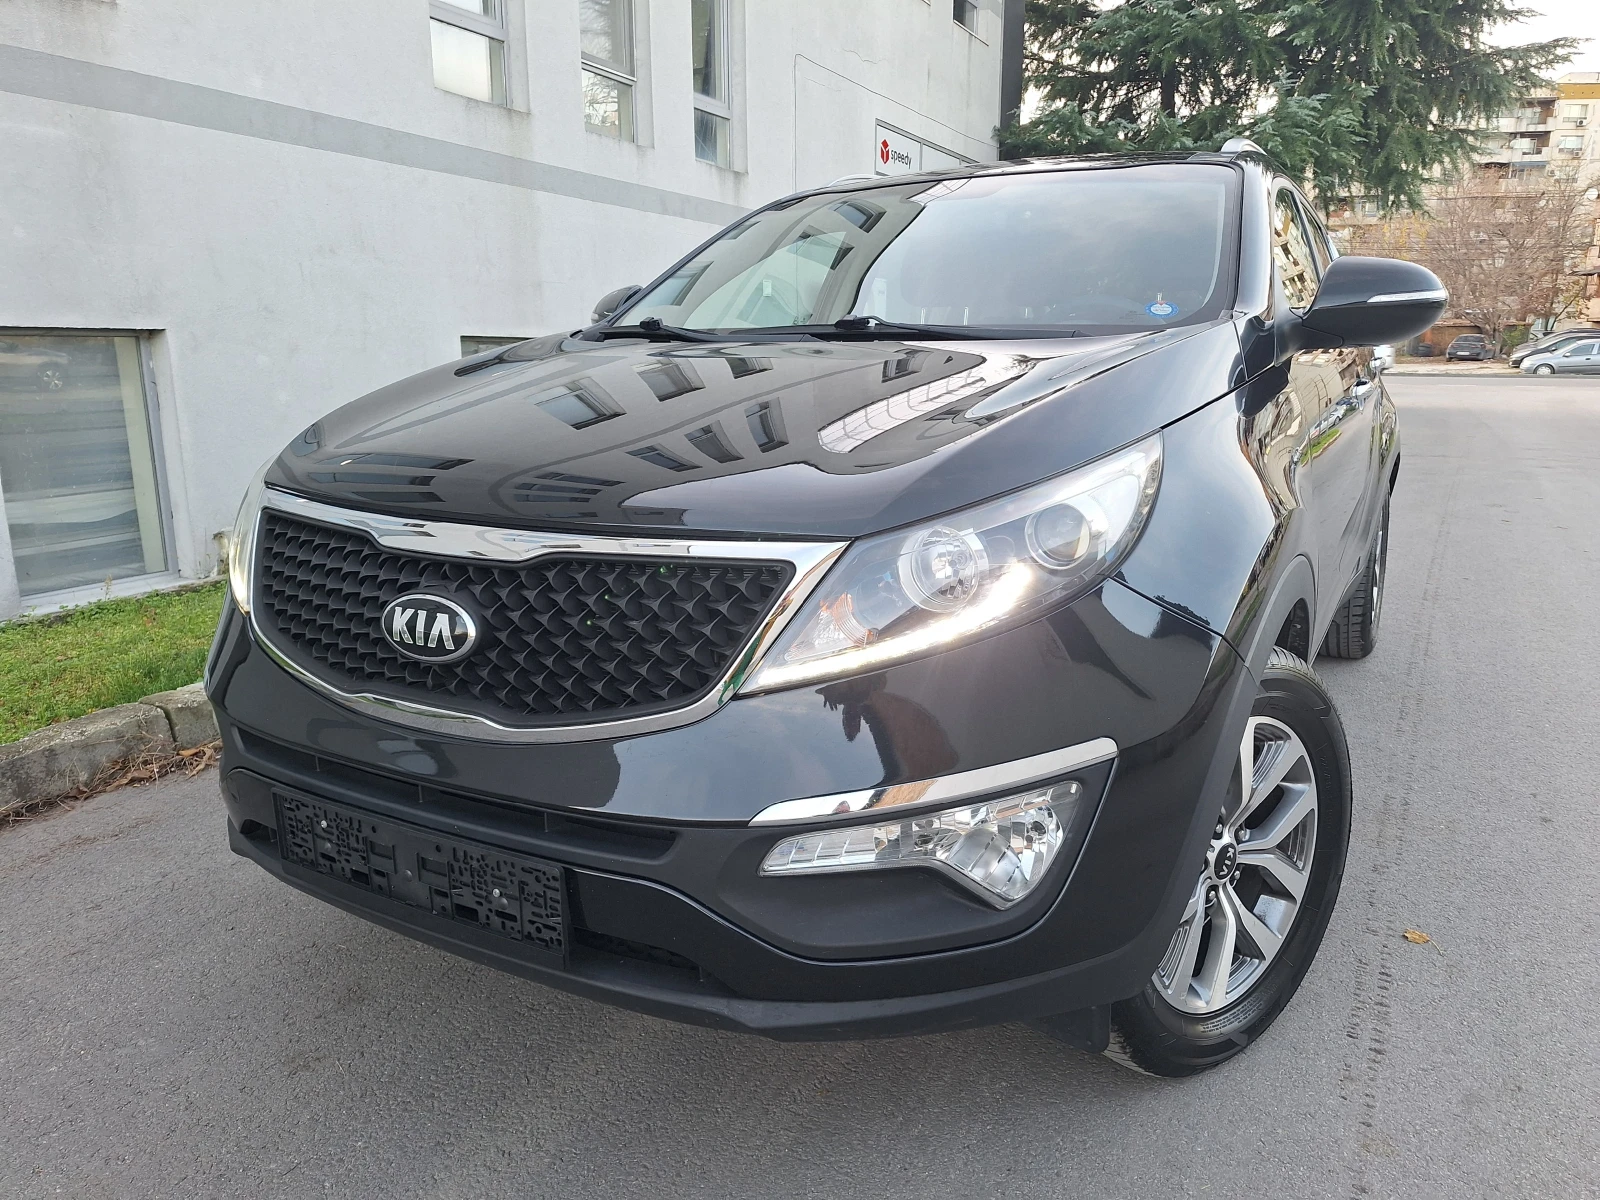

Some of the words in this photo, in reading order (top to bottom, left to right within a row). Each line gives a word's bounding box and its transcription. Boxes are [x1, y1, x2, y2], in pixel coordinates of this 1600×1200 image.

[890, 149, 912, 170] speedy
[392, 606, 455, 650] KIA
[1219, 847, 1235, 876] KIA
